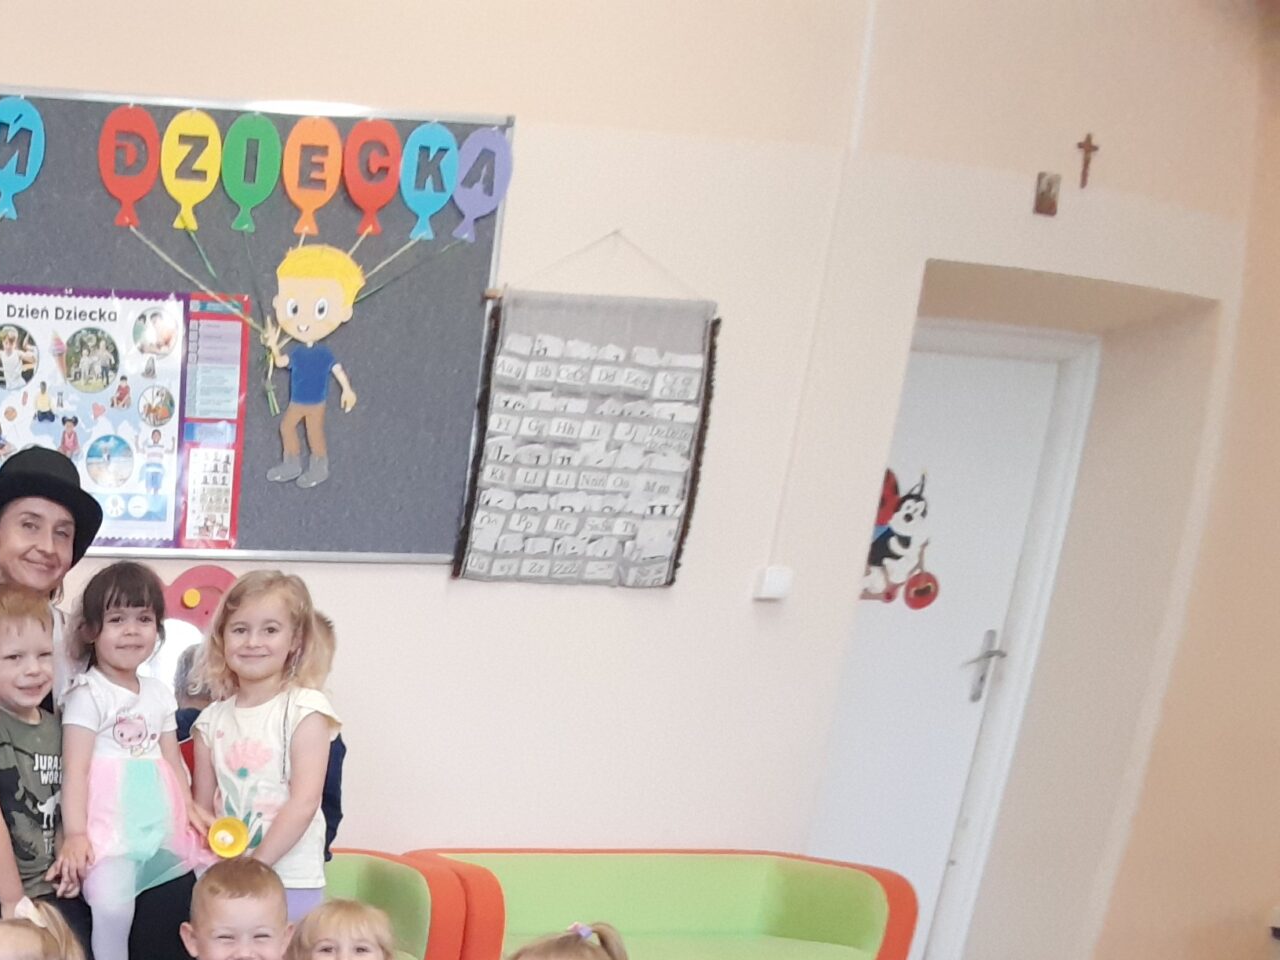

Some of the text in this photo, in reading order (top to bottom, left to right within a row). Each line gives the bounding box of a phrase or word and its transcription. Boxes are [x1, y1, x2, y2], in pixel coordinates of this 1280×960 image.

[113, 130, 497, 198] DZIECKA
[6, 303, 117, 322] Dzień Dziecka
[33, 753, 62, 771] JURA
